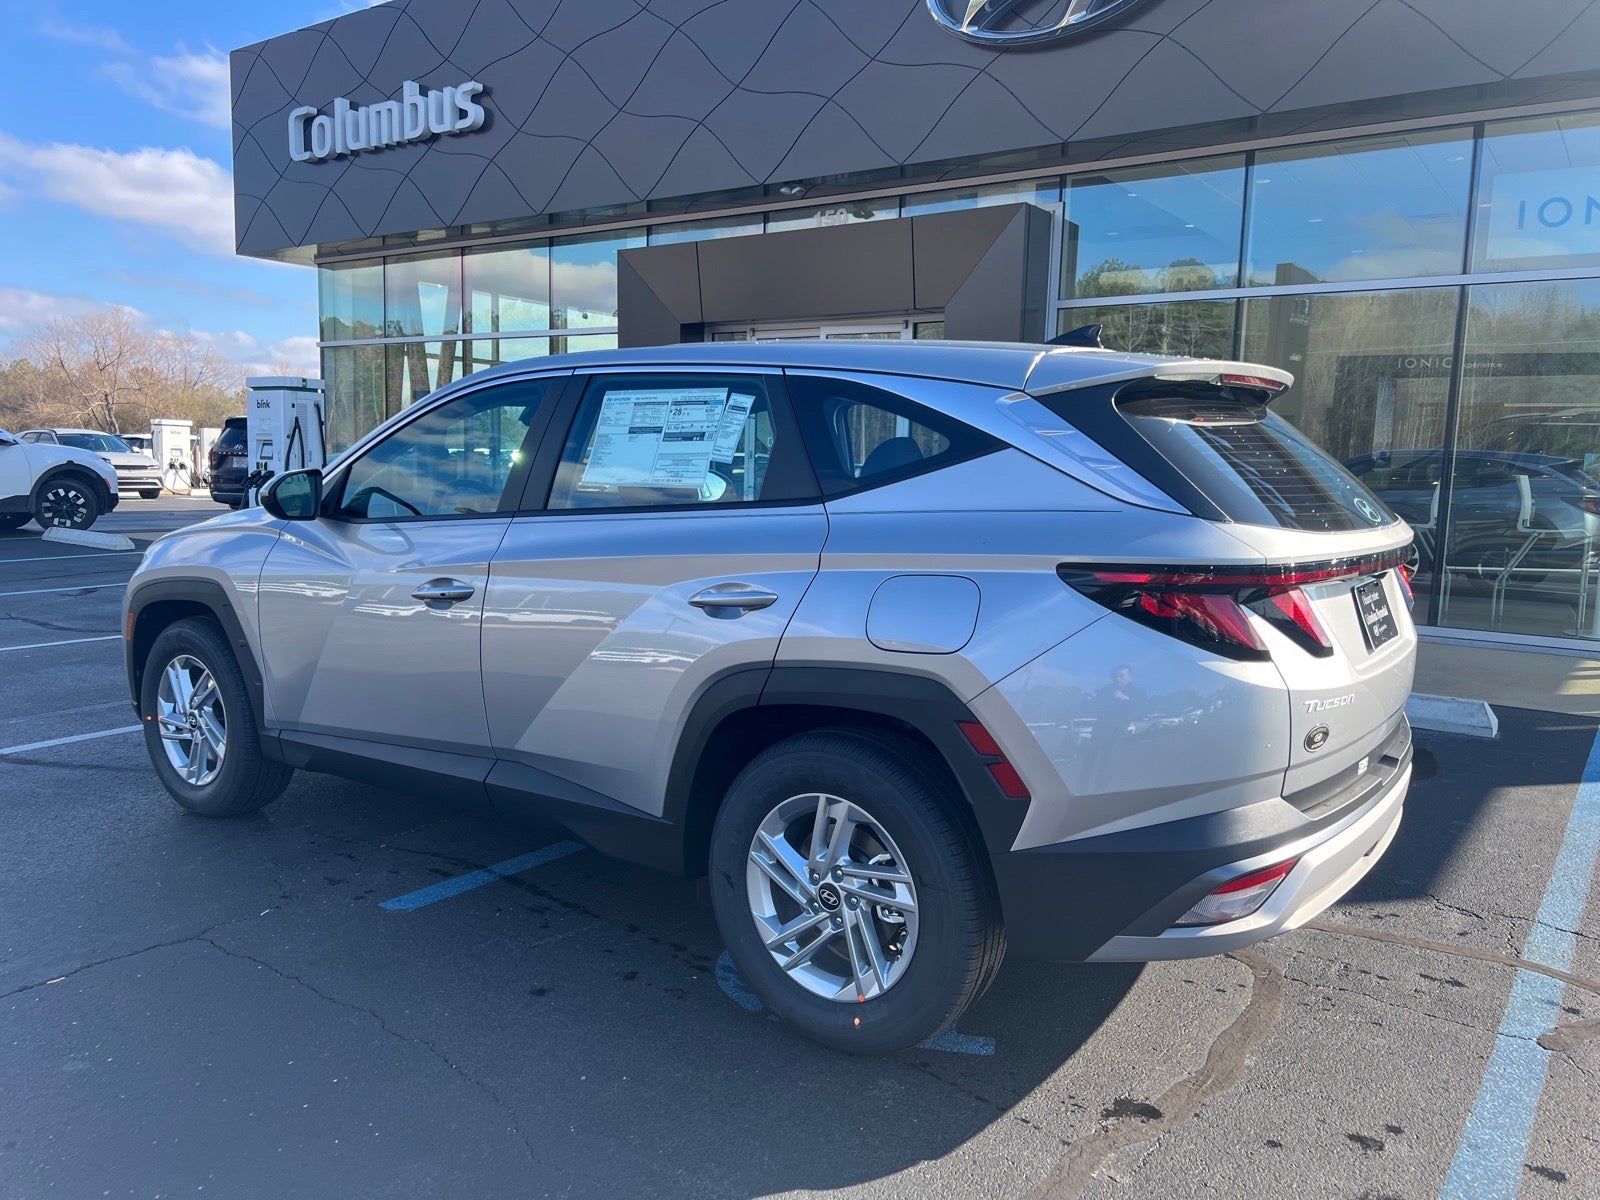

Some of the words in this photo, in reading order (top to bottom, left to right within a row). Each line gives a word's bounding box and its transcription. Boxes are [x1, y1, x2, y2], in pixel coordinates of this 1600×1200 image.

[288, 80, 485, 163] Columbus
[256, 399, 271, 409] blink
[673, 408, 682, 416] 28
